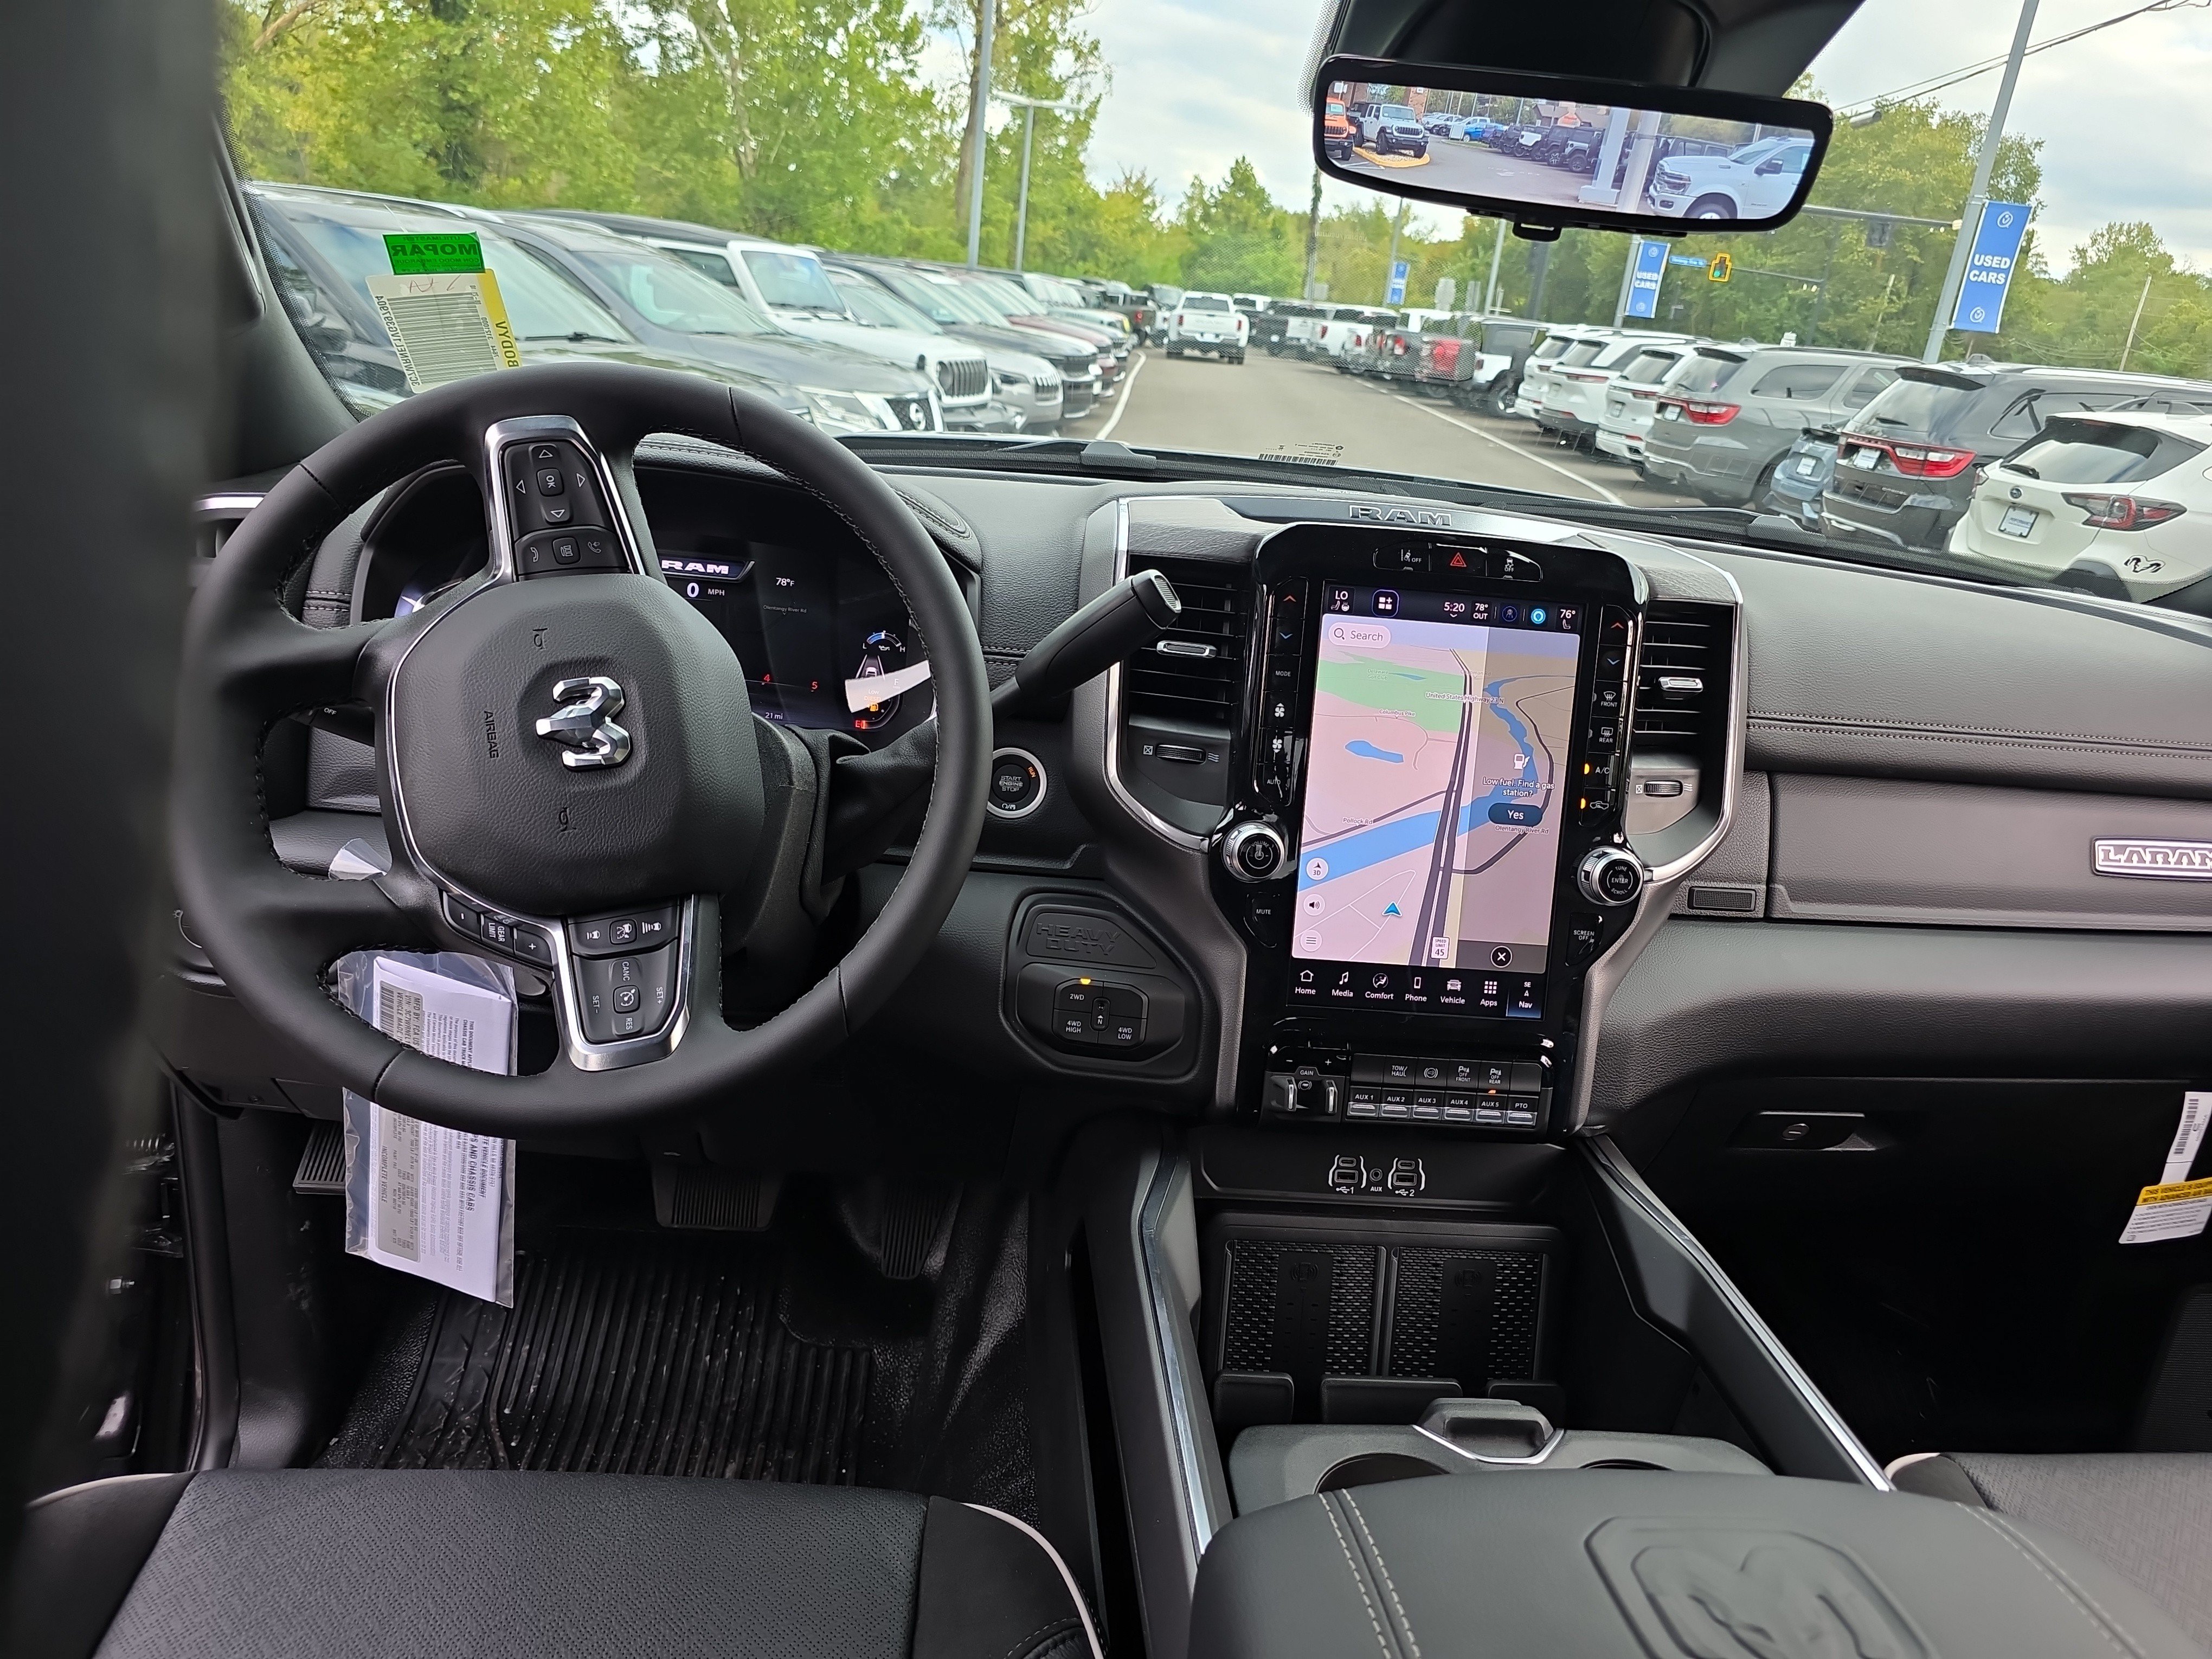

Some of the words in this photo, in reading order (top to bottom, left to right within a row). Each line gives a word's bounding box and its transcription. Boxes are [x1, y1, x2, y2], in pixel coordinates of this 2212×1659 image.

[1973, 254, 2010, 269] USED
[1637, 272, 1659, 281] USED
[1969, 270, 2006, 285] CARS
[546, 475, 556, 488] OK
[1348, 504, 1452, 527] RAM
[661, 560, 730, 575] RAM
[687, 582, 699, 597] 0
[708, 588, 725, 596] MPH
[1335, 590, 1348, 601] LO
[1443, 602, 1465, 613] 5:20
[1350, 631, 1384, 642] Search
[763, 674, 770, 683] 4
[811, 681, 818, 690] 5
[1465, 695, 1490, 703] Highway
[324, 707, 338, 716] OFF
[774, 712, 783, 720] mi
[484, 711, 499, 758] AIRBAG
[1028, 766, 1036, 778] RUN
[1595, 766, 1610, 774] A/C
[1483, 777, 1499, 786] Low
[1499, 778, 1516, 787] fuel.
[1517, 780, 1534, 788] Find
[1541, 782, 1554, 790] gas
[1502, 788, 1533, 797] station?
[1507, 810, 1524, 820] Yes
[1495, 825, 1525, 833] Olentangy
[497, 926, 505, 942] GEAR
[1036, 922, 1121, 943] HEAVY
[1046, 938, 1116, 956] DUTY
[1434, 948, 1445, 957] 45
[622, 961, 631, 981] CANC
[1295, 987, 1316, 995] Home
[1332, 988, 1353, 997] Media
[1365, 991, 1394, 1000] Comfort
[1405, 994, 1427, 1002] Phone
[1440, 996, 1465, 1005] Vehicle
[1480, 999, 1497, 1007] Apps
[1519, 1000, 1533, 1008] Nav
[413, 1012, 421, 1023] BY:
[413, 1024, 421, 1036] FCA
[413, 1037, 420, 1046] US
[469, 1144, 478, 1159] AND
[480, 1147, 488, 1168] VEHICLE
[467, 1161, 477, 1192] CHASSIS
[465, 1192, 475, 1211] CABS
